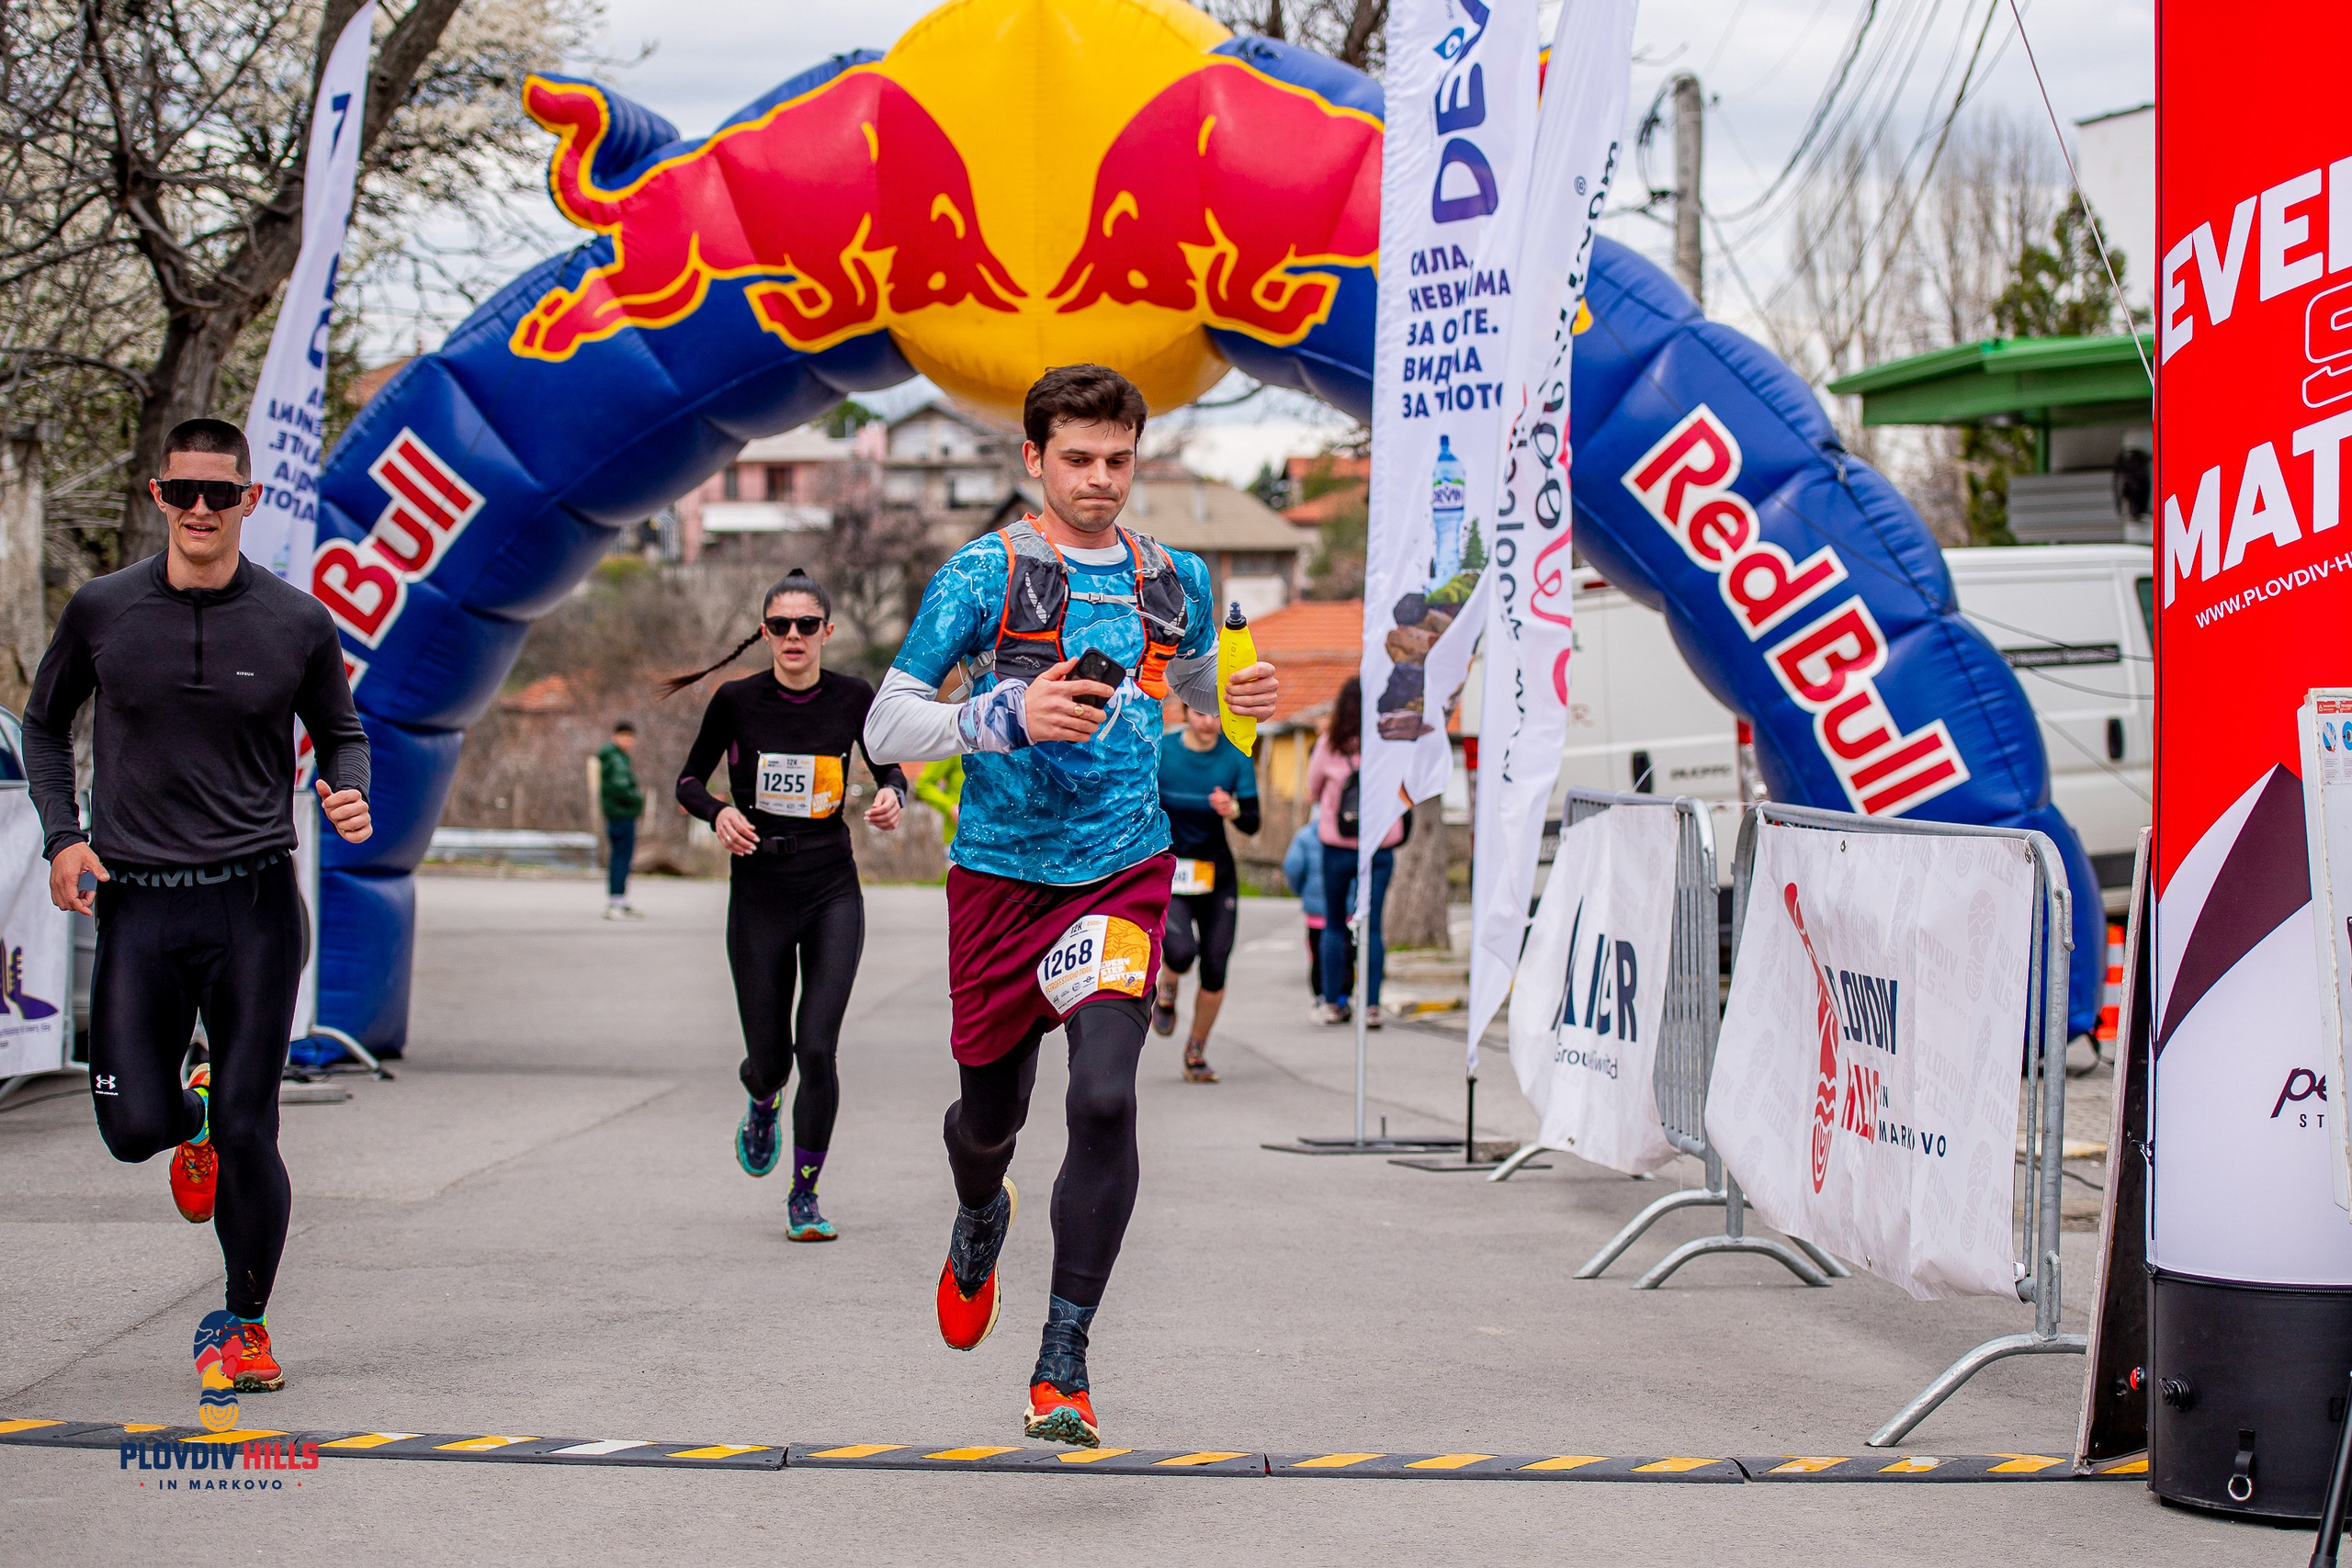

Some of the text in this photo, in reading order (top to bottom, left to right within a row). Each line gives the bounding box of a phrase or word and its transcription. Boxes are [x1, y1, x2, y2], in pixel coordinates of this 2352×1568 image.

[313, 439, 472, 637] Bull
[1632, 416, 1957, 816] Red Bull
[763, 773, 806, 793] 1255
[1044, 939, 1093, 981] 1268
